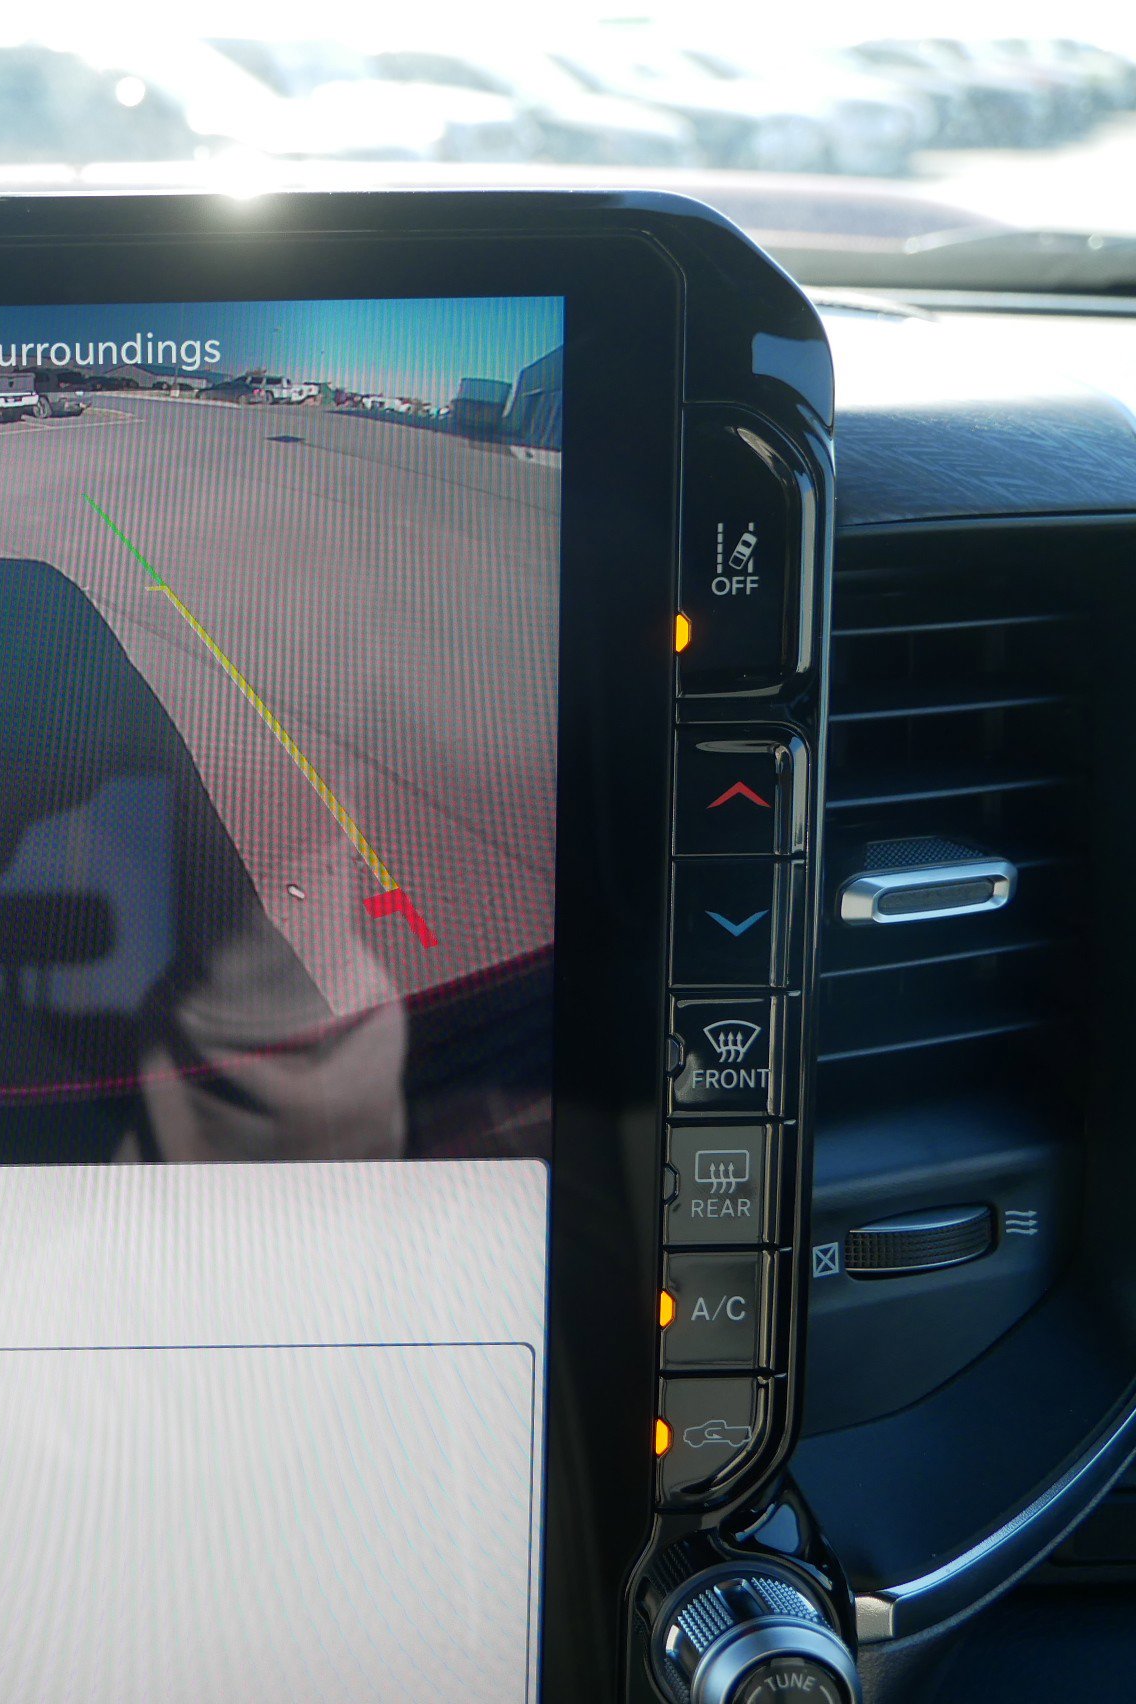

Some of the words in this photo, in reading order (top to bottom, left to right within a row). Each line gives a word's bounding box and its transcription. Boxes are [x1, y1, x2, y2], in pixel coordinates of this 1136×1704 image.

[711, 575, 759, 595] OFF
[692, 1068, 769, 1089] FRONT
[691, 1199, 751, 1218] REAR
[691, 1295, 746, 1321] A/C
[764, 1672, 816, 1692] TUNE
